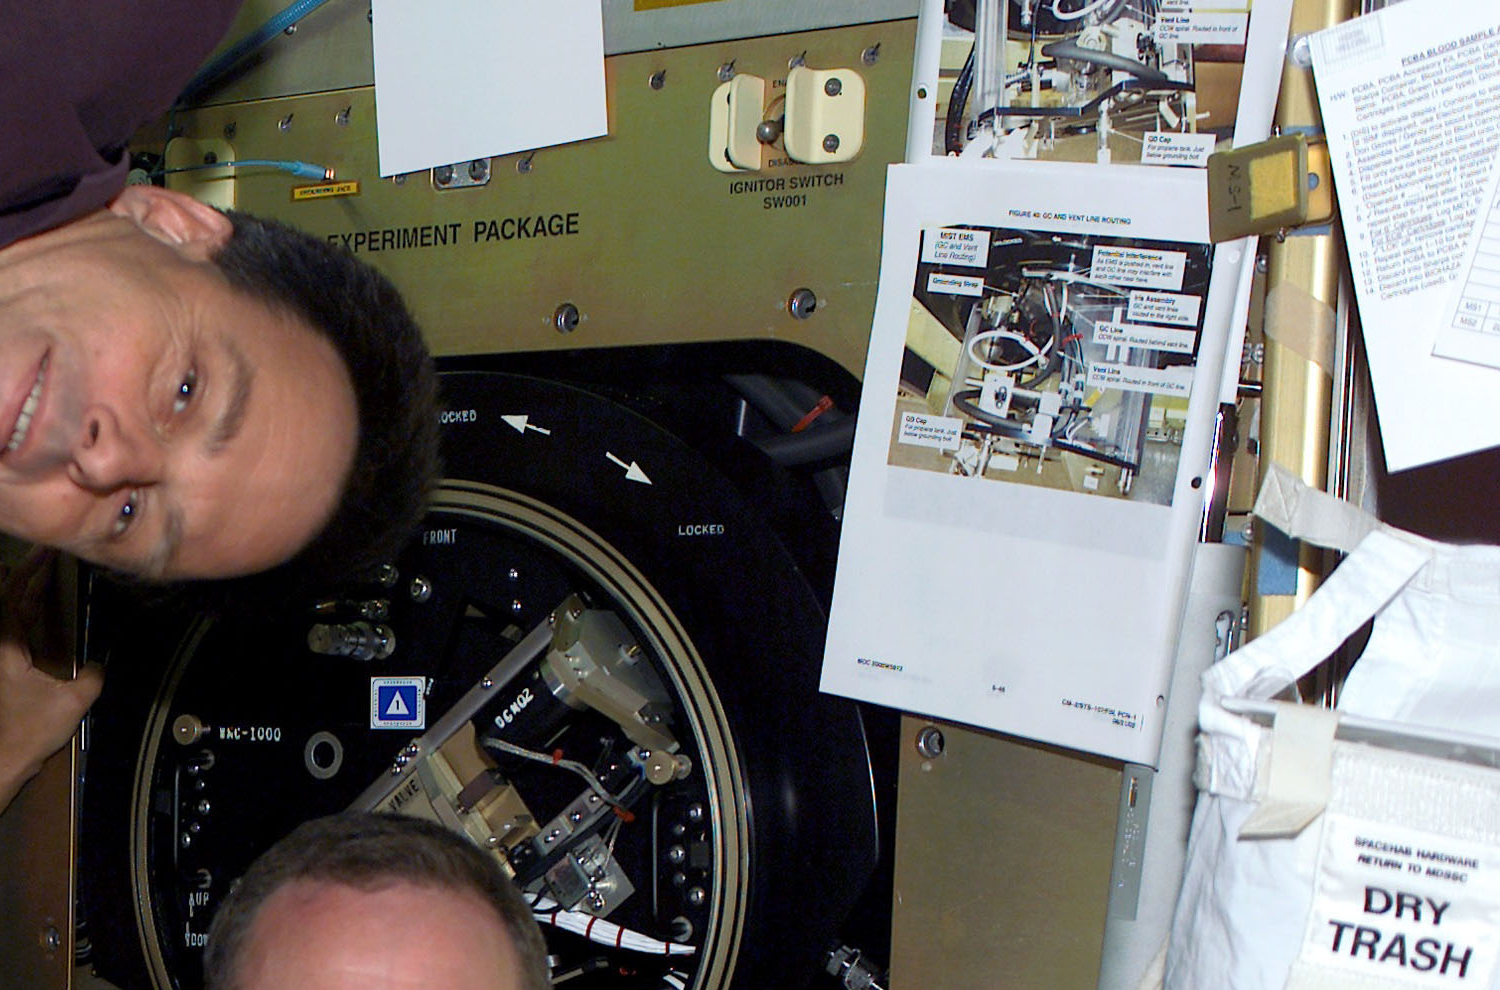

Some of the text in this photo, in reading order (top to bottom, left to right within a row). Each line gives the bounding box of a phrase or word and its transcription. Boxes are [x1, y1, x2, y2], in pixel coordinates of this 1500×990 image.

[1401, 27, 1496, 67] PCBA BLOOD SAMPLE
[730, 173, 844, 194] IGNITOR SWITCH
[763, 194, 807, 210] SW001
[1008, 210, 1031, 218] FIGURE
[1068, 214, 1085, 222] VENT
[1086, 215, 1100, 223] LINE
[1101, 217, 1131, 225] ROUTING
[474, 212, 580, 243] PACKAGE
[1146, 295, 1176, 305] Assembly
[438, 409, 477, 425] OCKED
[423, 528, 457, 546] FRONT
[678, 524, 725, 537] LOCKED
[396, 700, 400, 710] 1
[388, 779, 420, 813] VALVE
[1355, 836, 1480, 870] SPACEHAB HARDWARE
[1357, 853, 1403, 871] RETURN
[1407, 862, 1422, 873] TO
[195, 891, 209, 906] UP
[1364, 885, 1451, 926] DRY
[1328, 919, 1474, 979] TRASH
